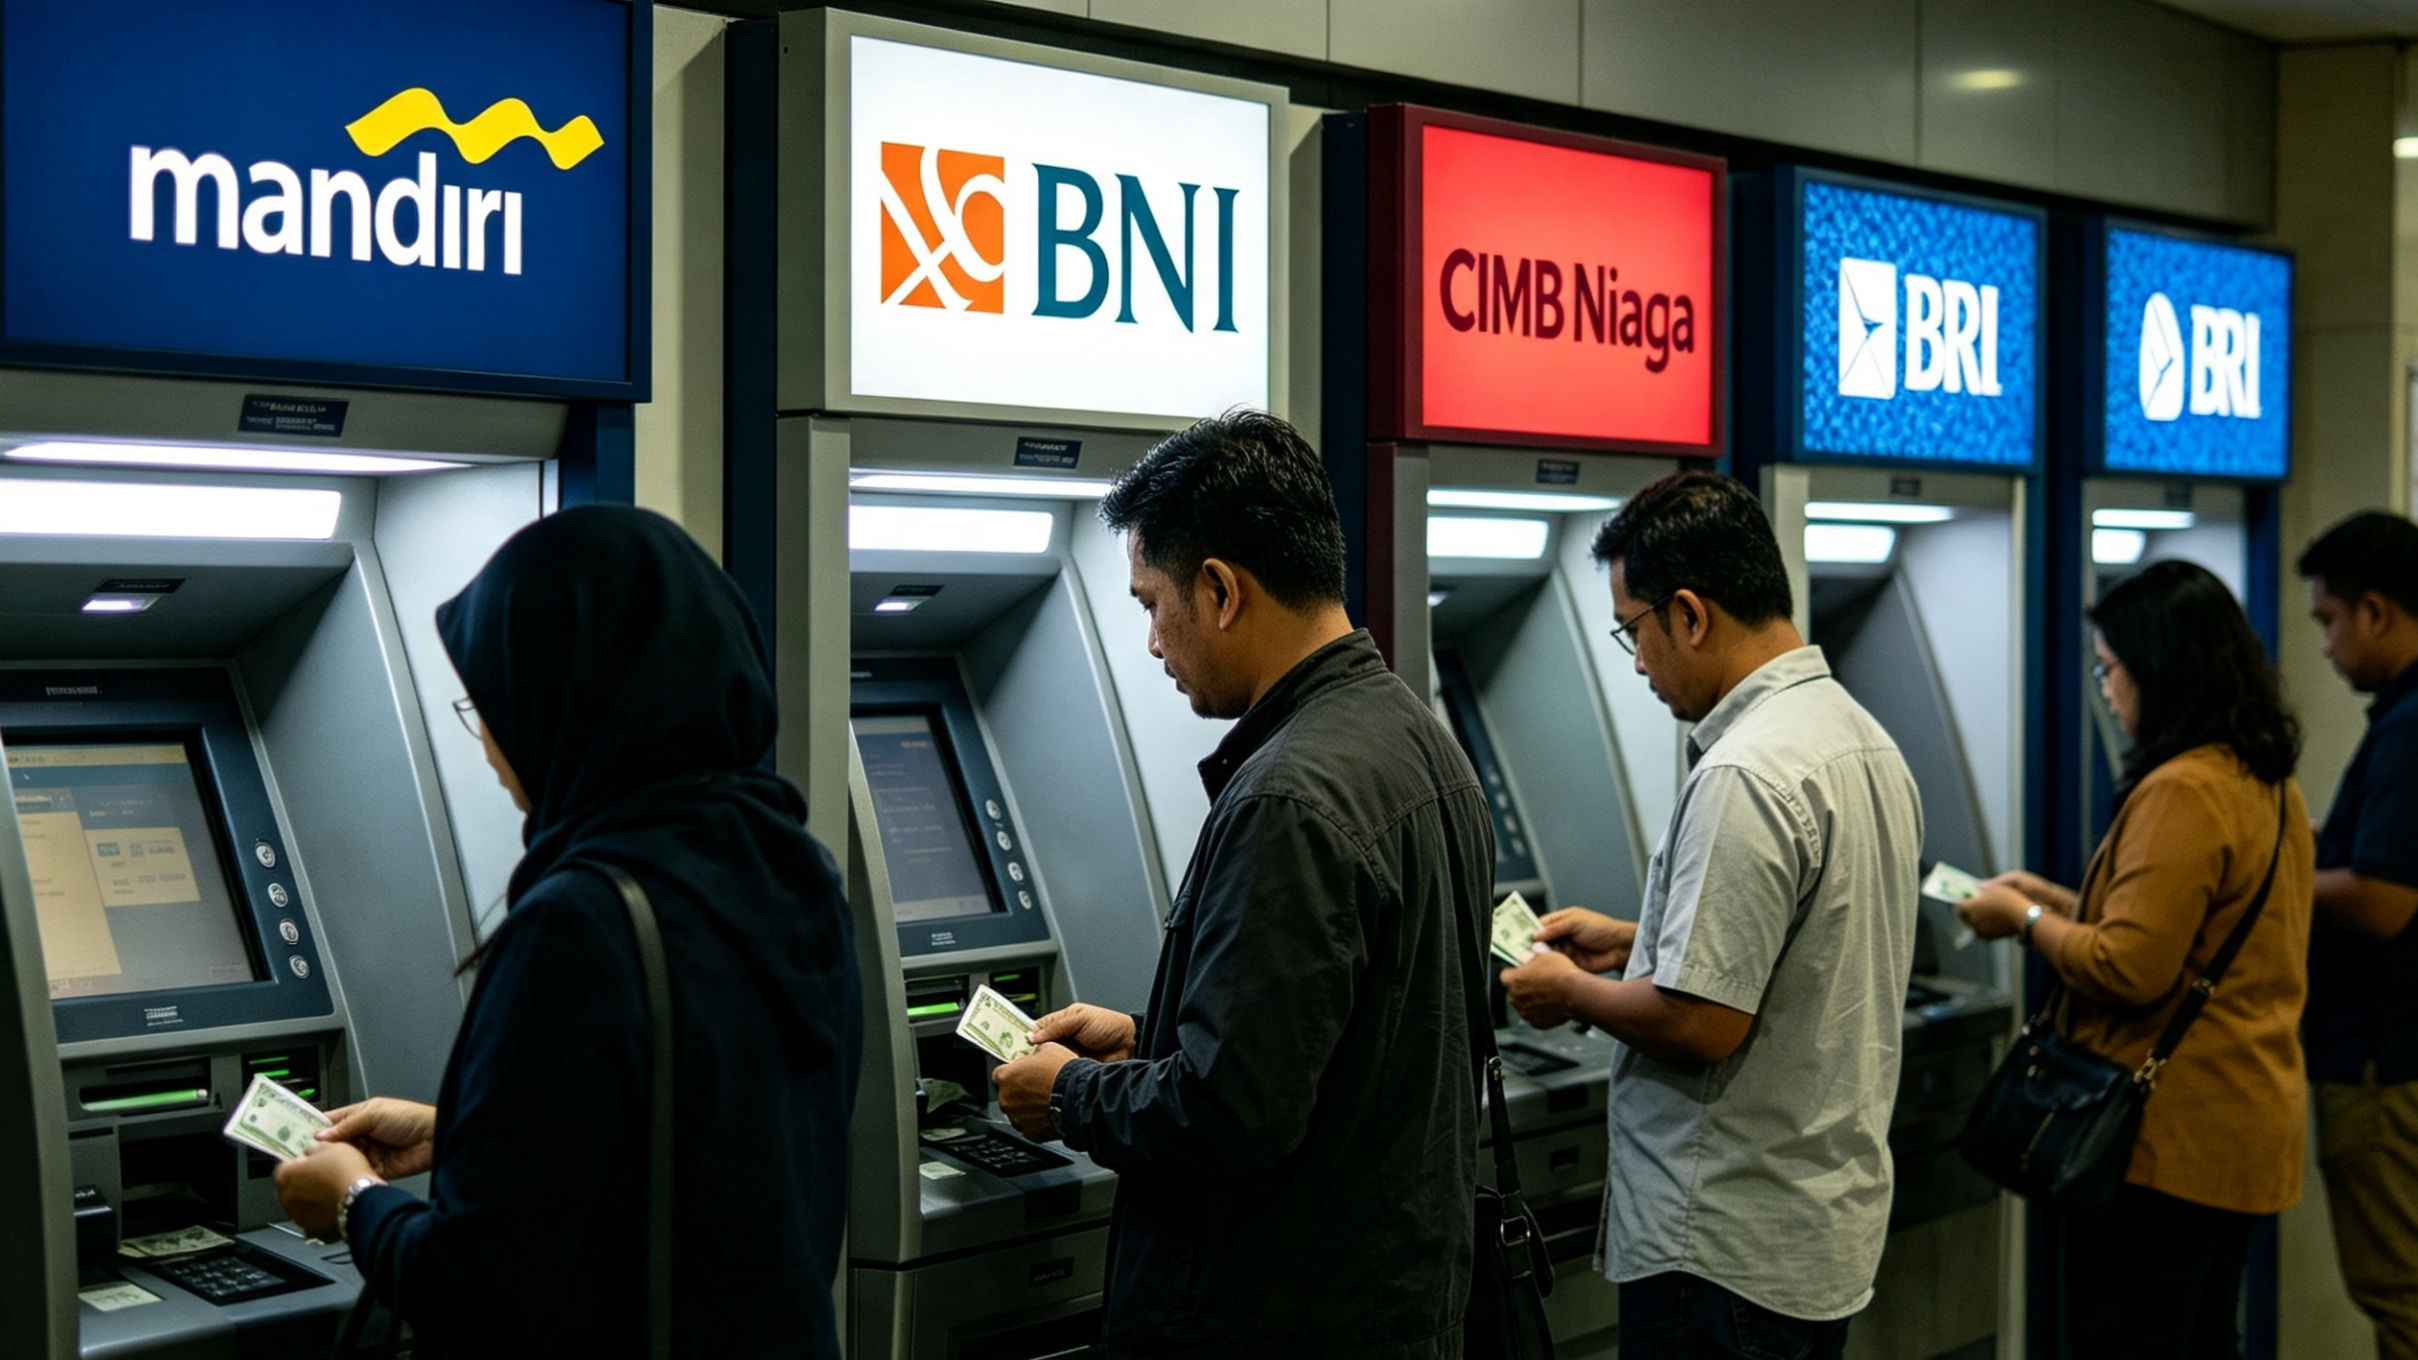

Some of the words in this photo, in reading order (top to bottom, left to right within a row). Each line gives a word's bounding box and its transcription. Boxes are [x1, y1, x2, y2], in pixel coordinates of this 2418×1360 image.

[129, 145, 523, 275] mandiri
[1031, 163, 1240, 334] BNI
[1440, 248, 1564, 339] CIMB
[1574, 263, 1694, 374] Niaga
[1904, 274, 2002, 396] BRI
[2190, 305, 2261, 419] BRI
